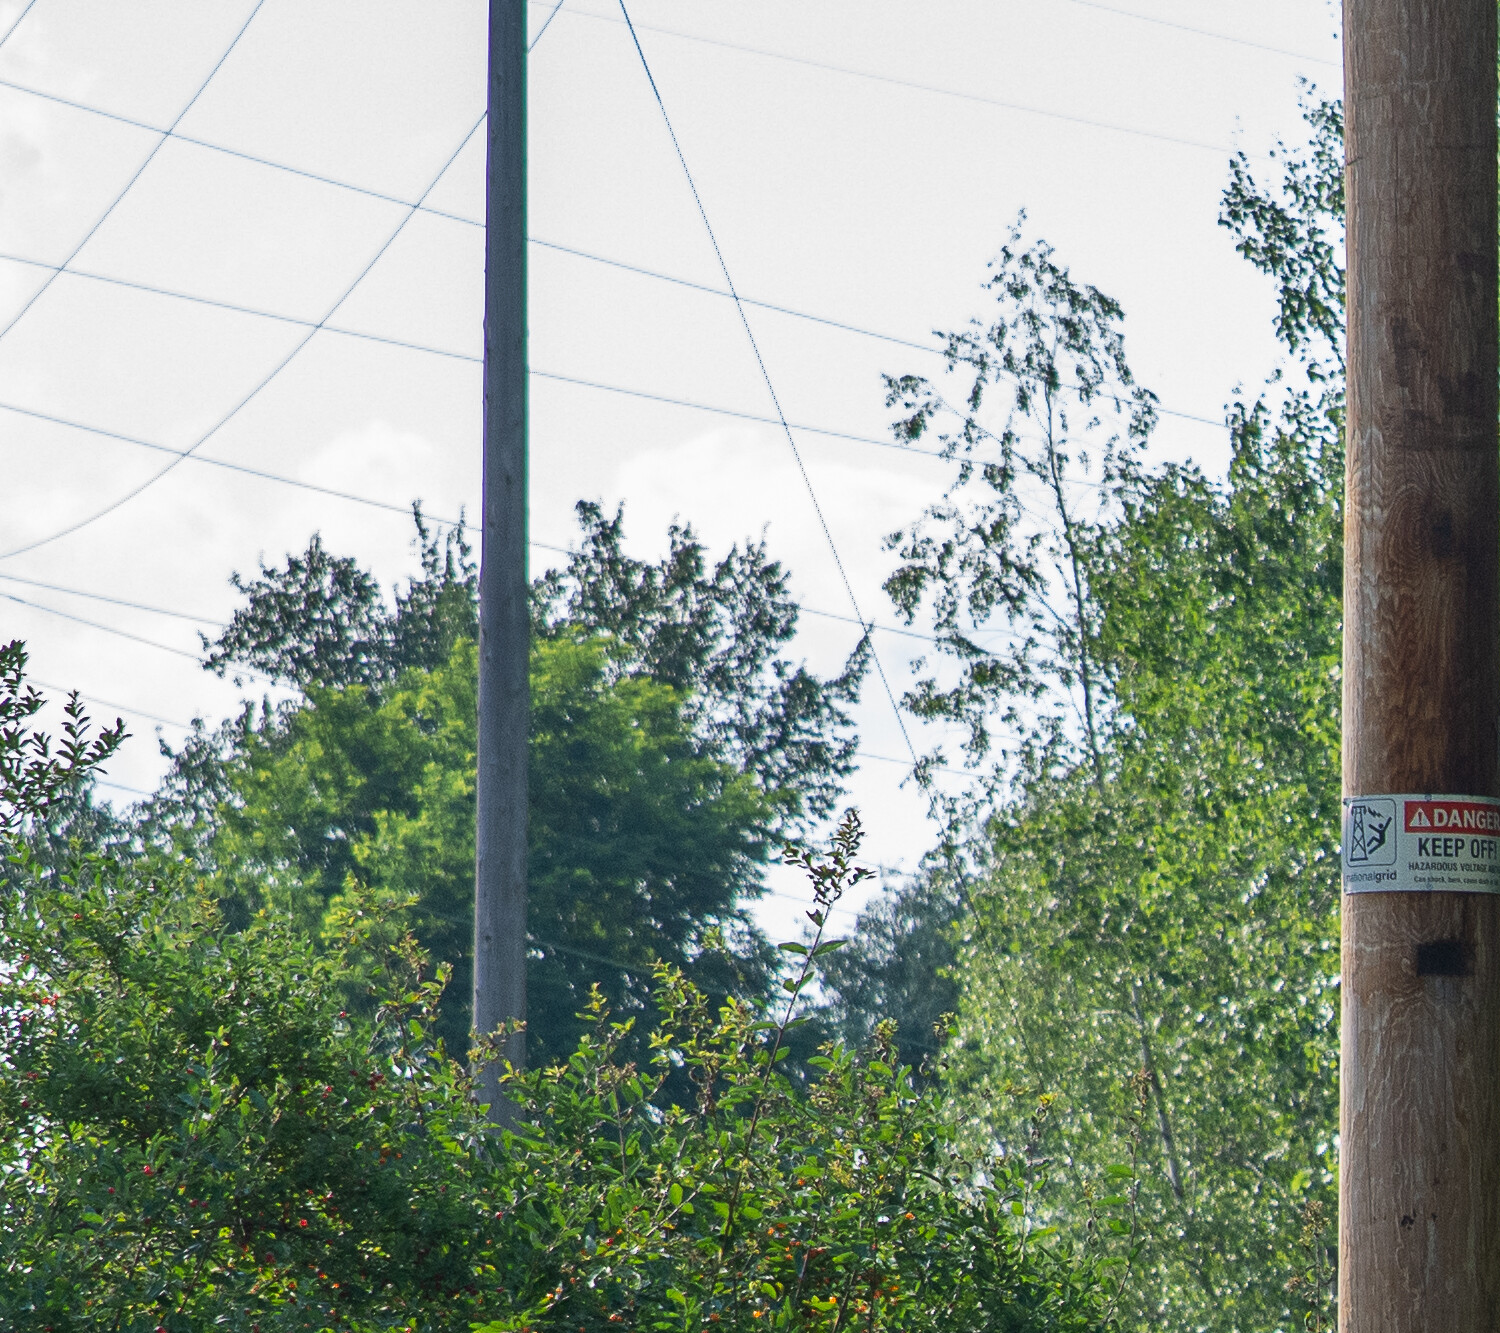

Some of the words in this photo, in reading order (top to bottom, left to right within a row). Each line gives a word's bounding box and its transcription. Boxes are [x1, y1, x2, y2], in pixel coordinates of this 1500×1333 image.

[1433, 808, 1500, 831] DANGER
[1418, 837, 1465, 857] KEEP
[1470, 838, 1498, 860] OFF!
[1408, 861, 1458, 872] HAZARDOUS
[1460, 863, 1488, 873] VOLTAGE
